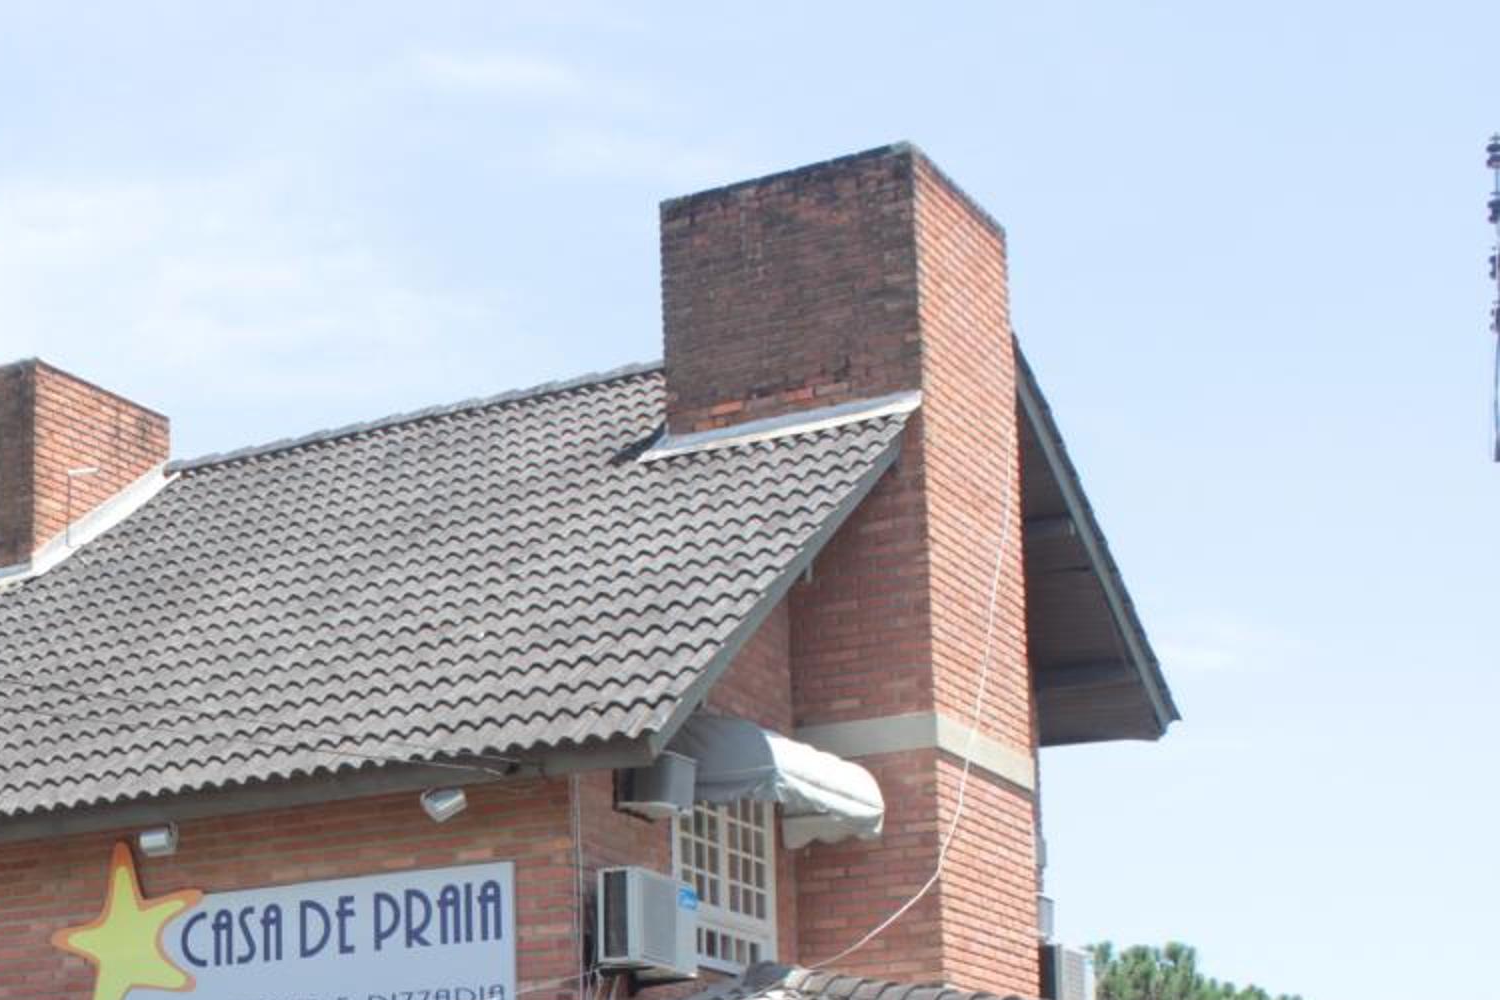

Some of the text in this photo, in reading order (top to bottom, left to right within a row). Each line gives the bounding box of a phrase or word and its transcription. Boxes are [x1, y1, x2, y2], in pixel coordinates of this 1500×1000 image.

[181, 879, 503, 968] CASA DE PRAIA
